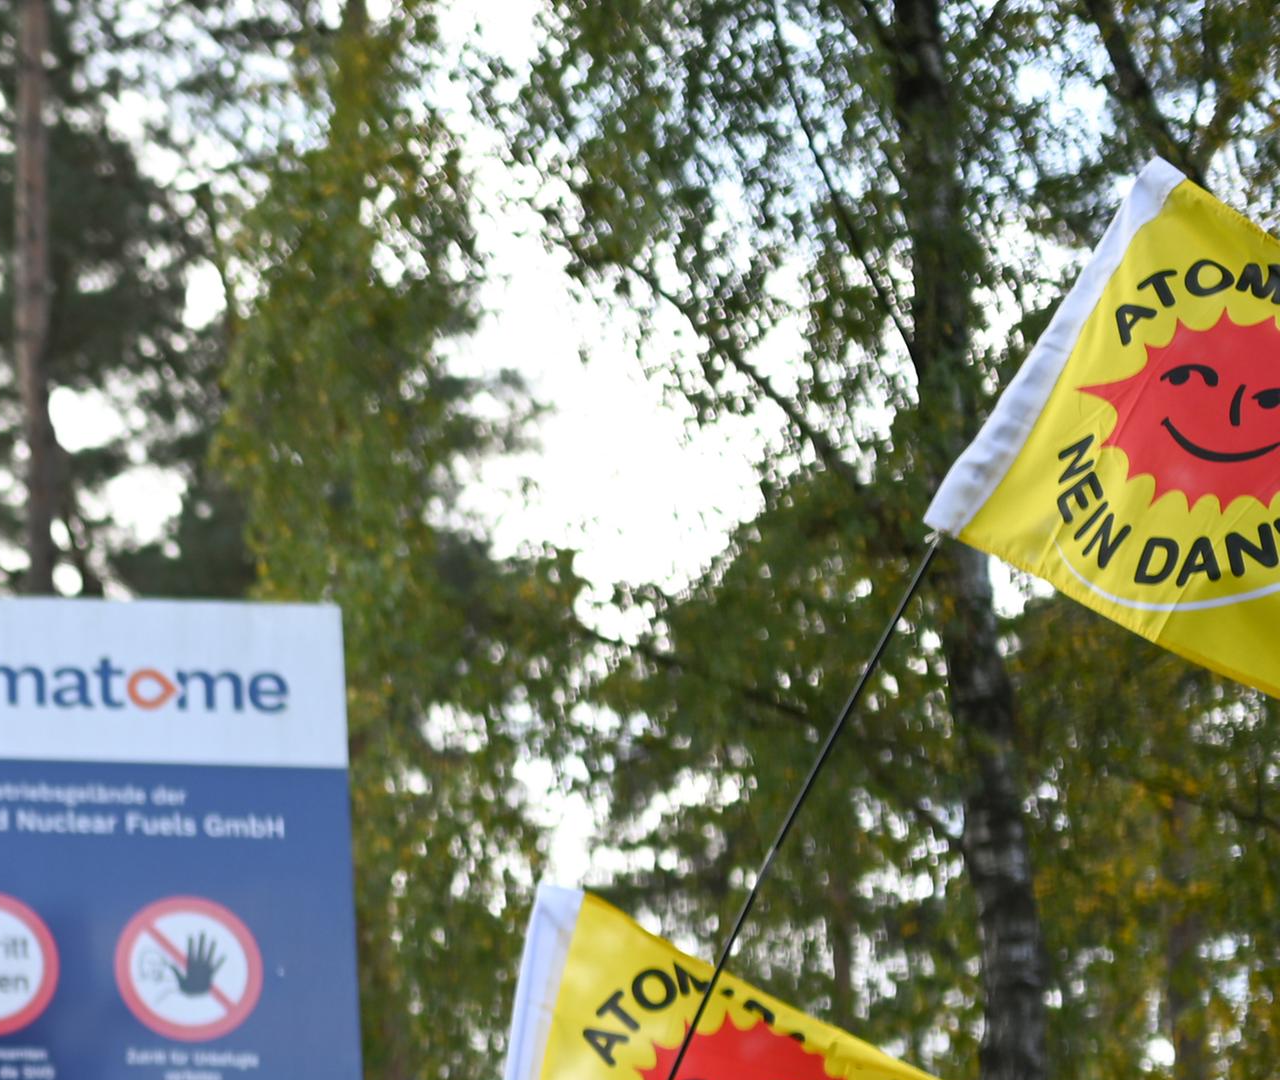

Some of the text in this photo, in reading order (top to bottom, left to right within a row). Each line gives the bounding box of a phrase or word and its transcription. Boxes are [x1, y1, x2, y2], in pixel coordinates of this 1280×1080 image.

[1056, 432, 1280, 588] NEIN DAN
[151, 785, 187, 806] der
[15, 808, 117, 836] Nuclear
[124, 811, 197, 838] Fuels
[203, 813, 286, 839] GmbH
